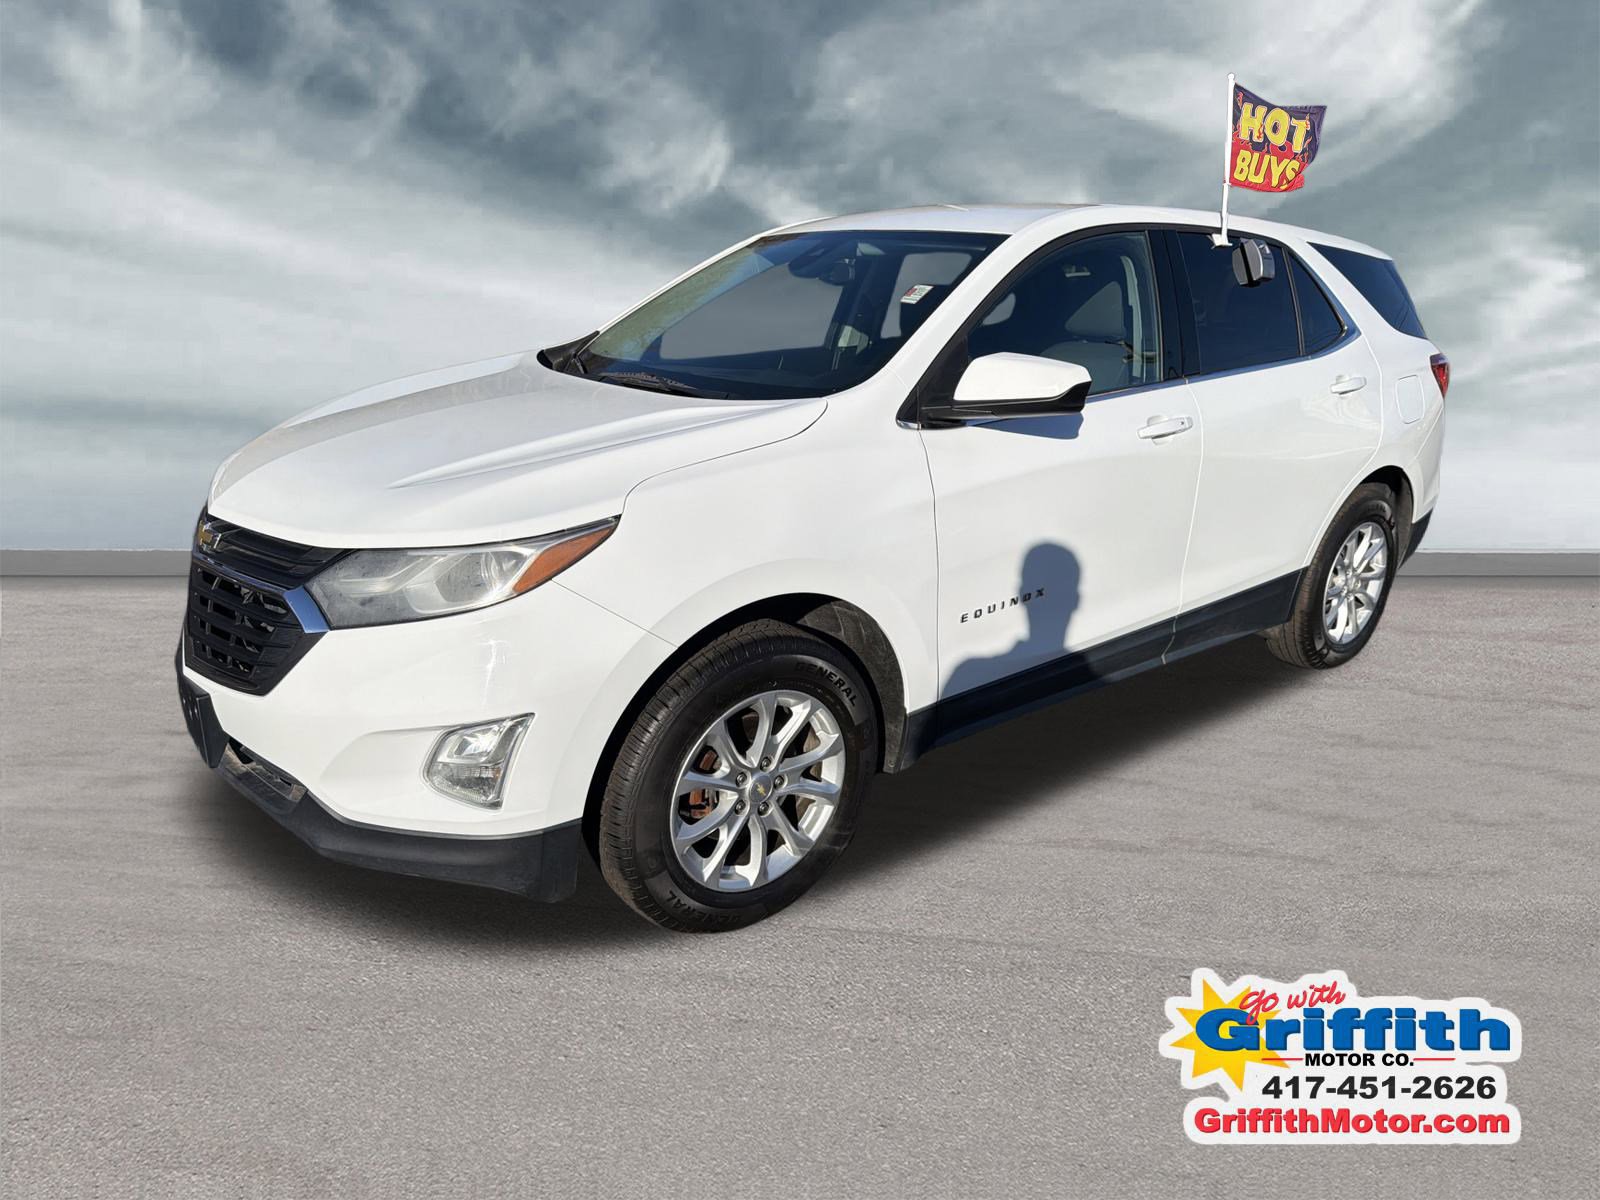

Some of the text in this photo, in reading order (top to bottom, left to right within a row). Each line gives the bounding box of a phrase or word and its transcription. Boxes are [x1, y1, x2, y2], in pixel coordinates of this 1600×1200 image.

[1239, 102, 1309, 153] HOT
[1233, 149, 1301, 190] BUYS
[960, 587, 1045, 624] EQUINOX
